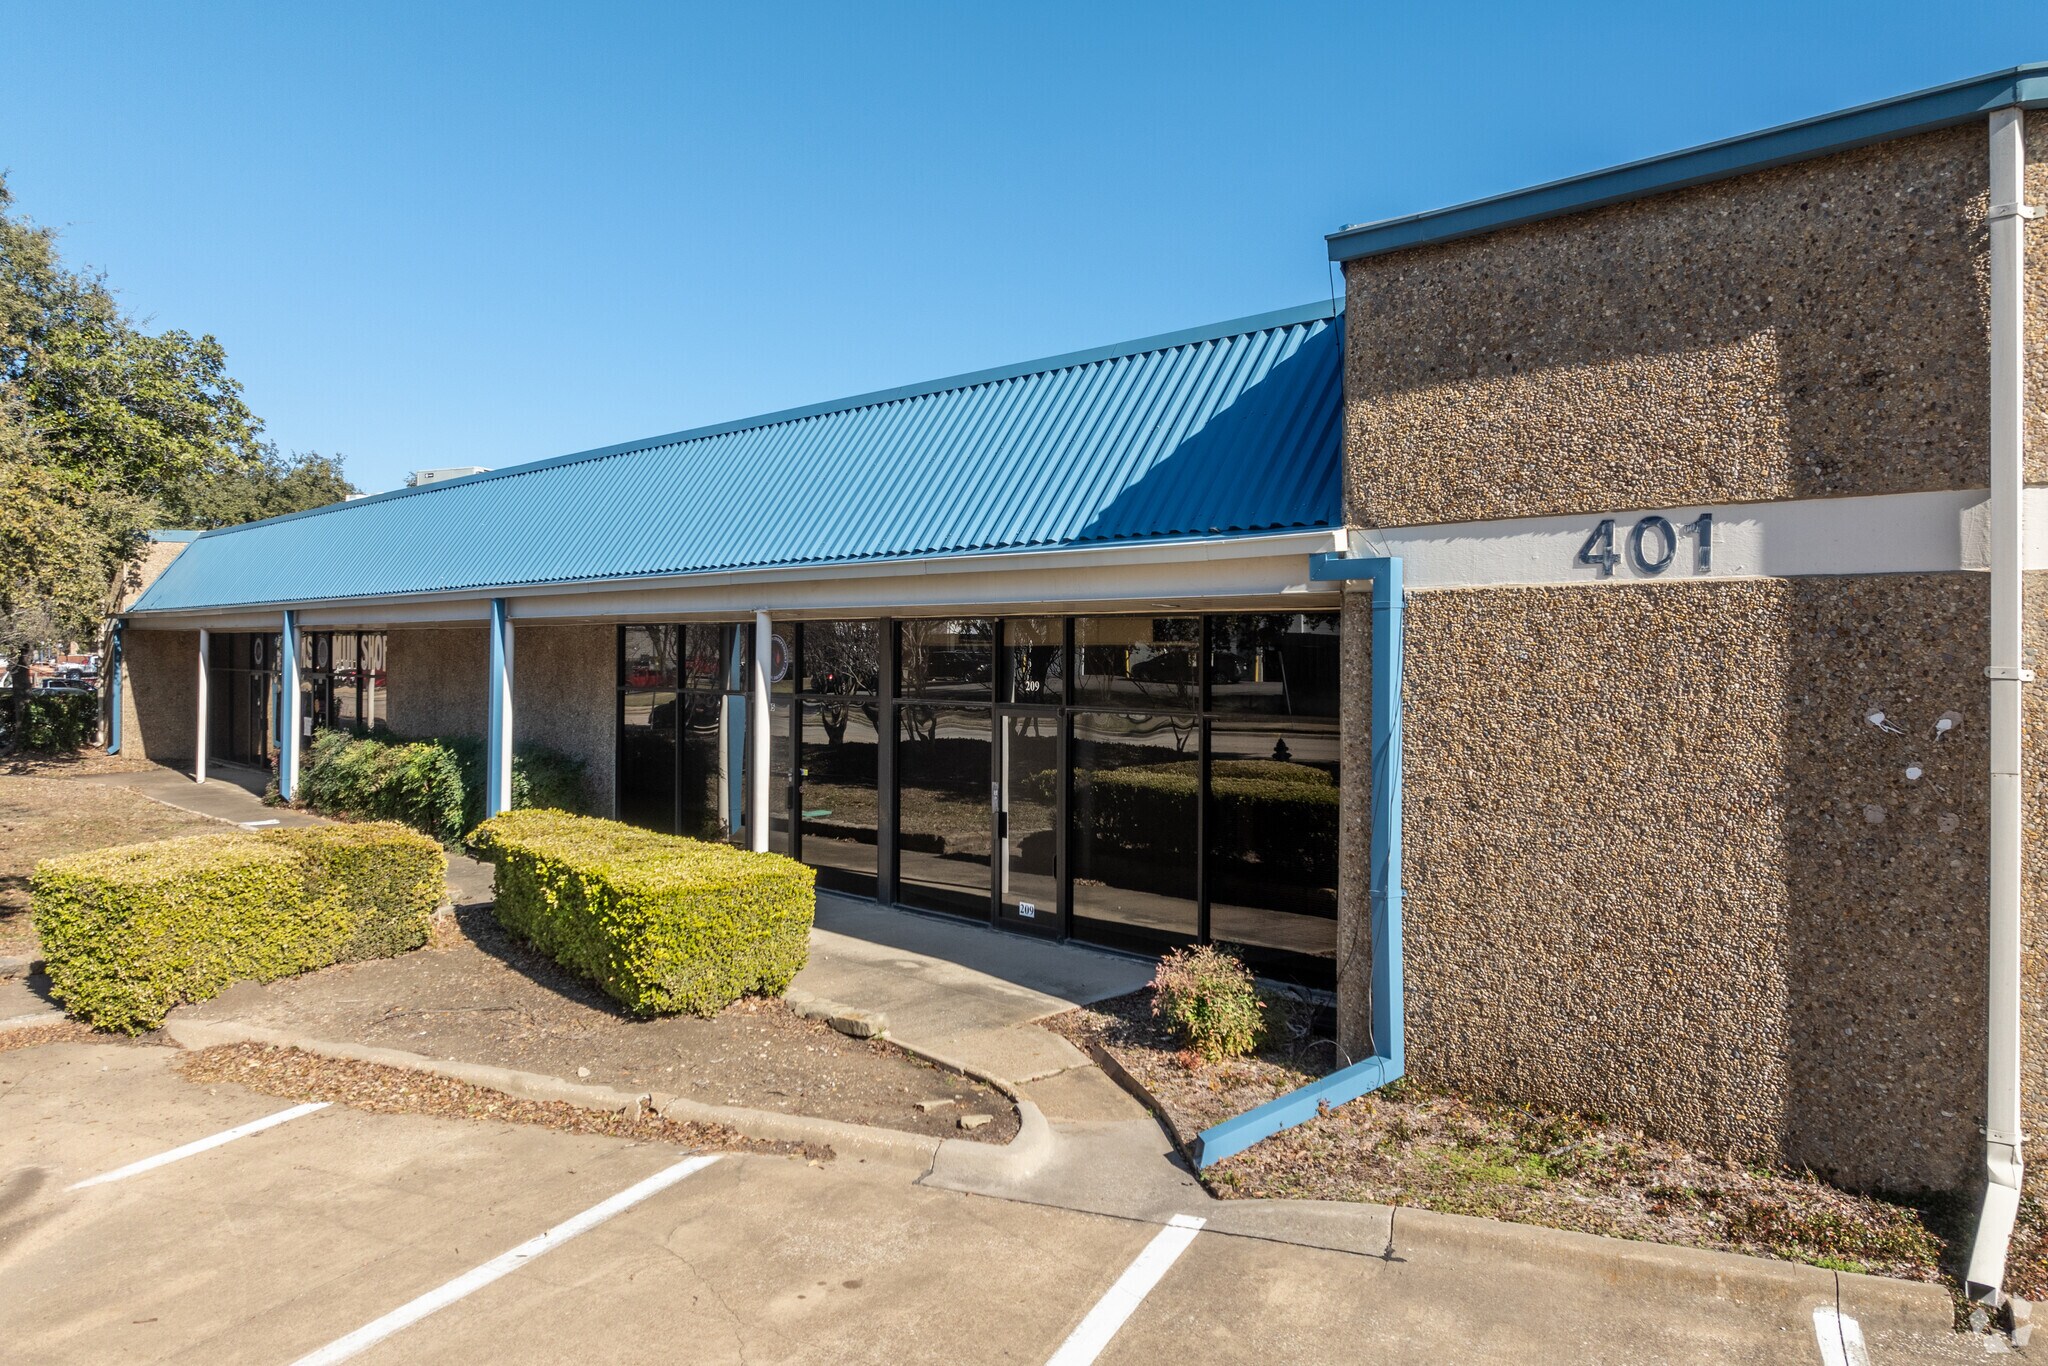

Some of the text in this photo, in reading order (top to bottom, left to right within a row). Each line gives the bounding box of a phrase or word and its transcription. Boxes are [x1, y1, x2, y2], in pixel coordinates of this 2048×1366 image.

[1578, 513, 1713, 576] 401
[1025, 680, 1040, 693] 209
[1020, 903, 1034, 916] 209
